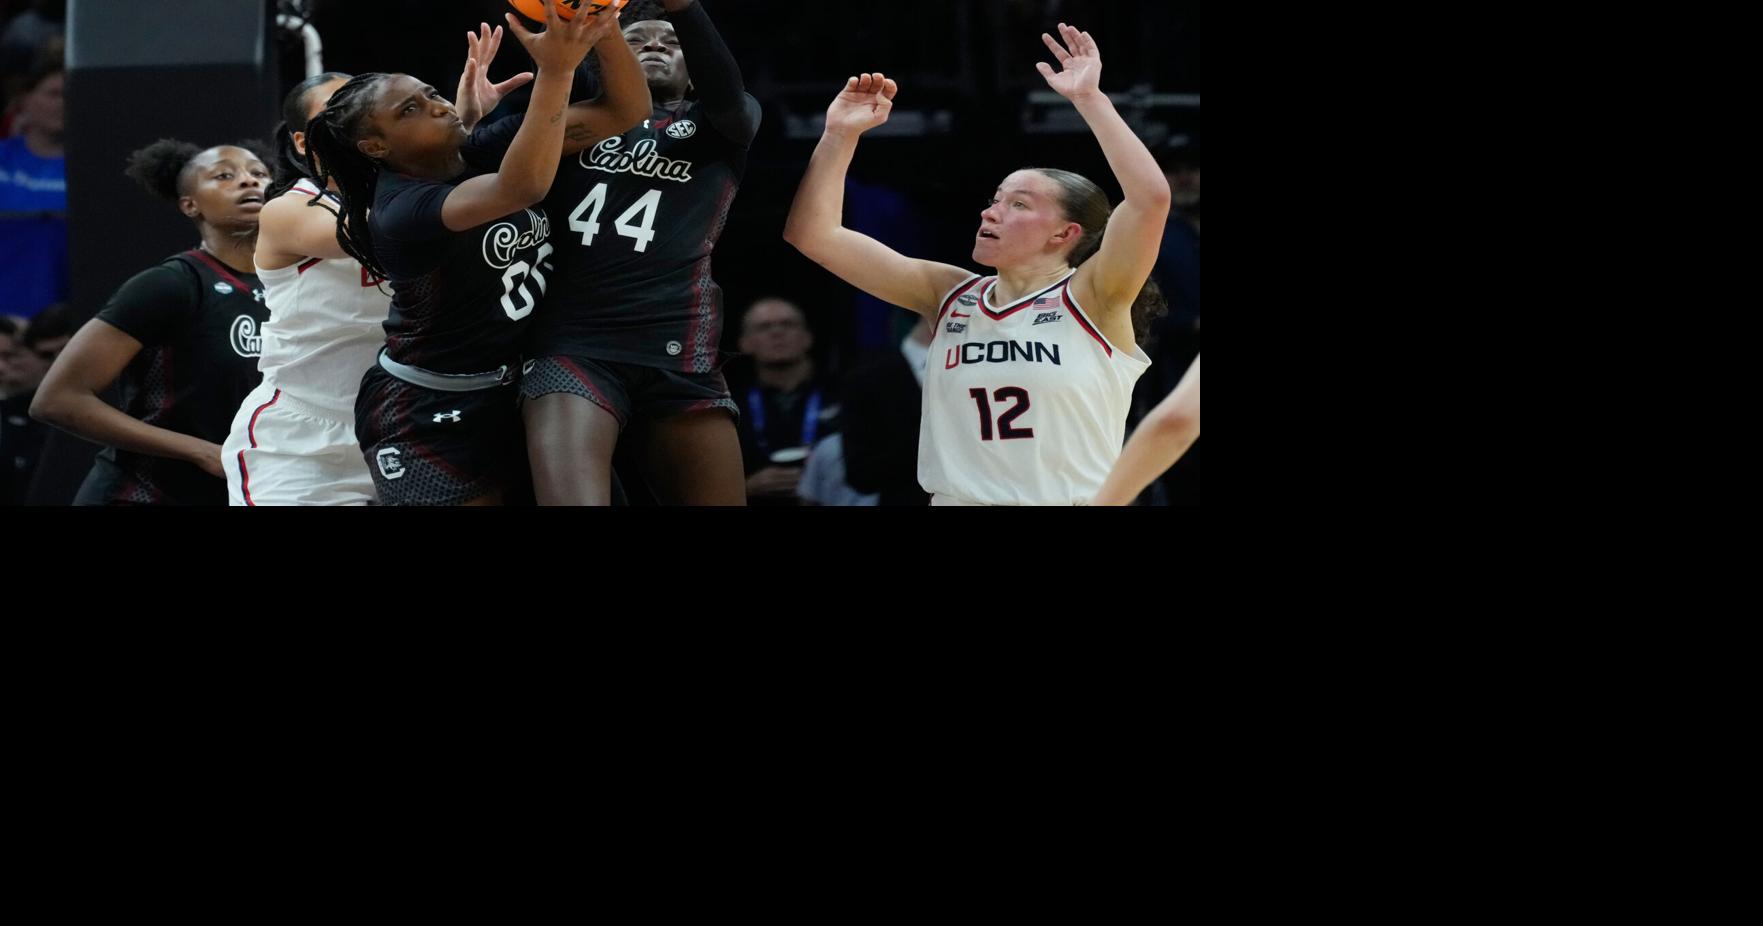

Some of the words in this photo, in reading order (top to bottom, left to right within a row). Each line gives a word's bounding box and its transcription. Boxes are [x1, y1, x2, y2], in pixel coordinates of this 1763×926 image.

[668, 121, 693, 137] SEC
[579, 136, 692, 182] Caolina
[568, 182, 662, 253] 44
[1034, 315, 1063, 323] EAST
[945, 340, 1061, 370] UCONN
[969, 386, 1034, 441] 12
